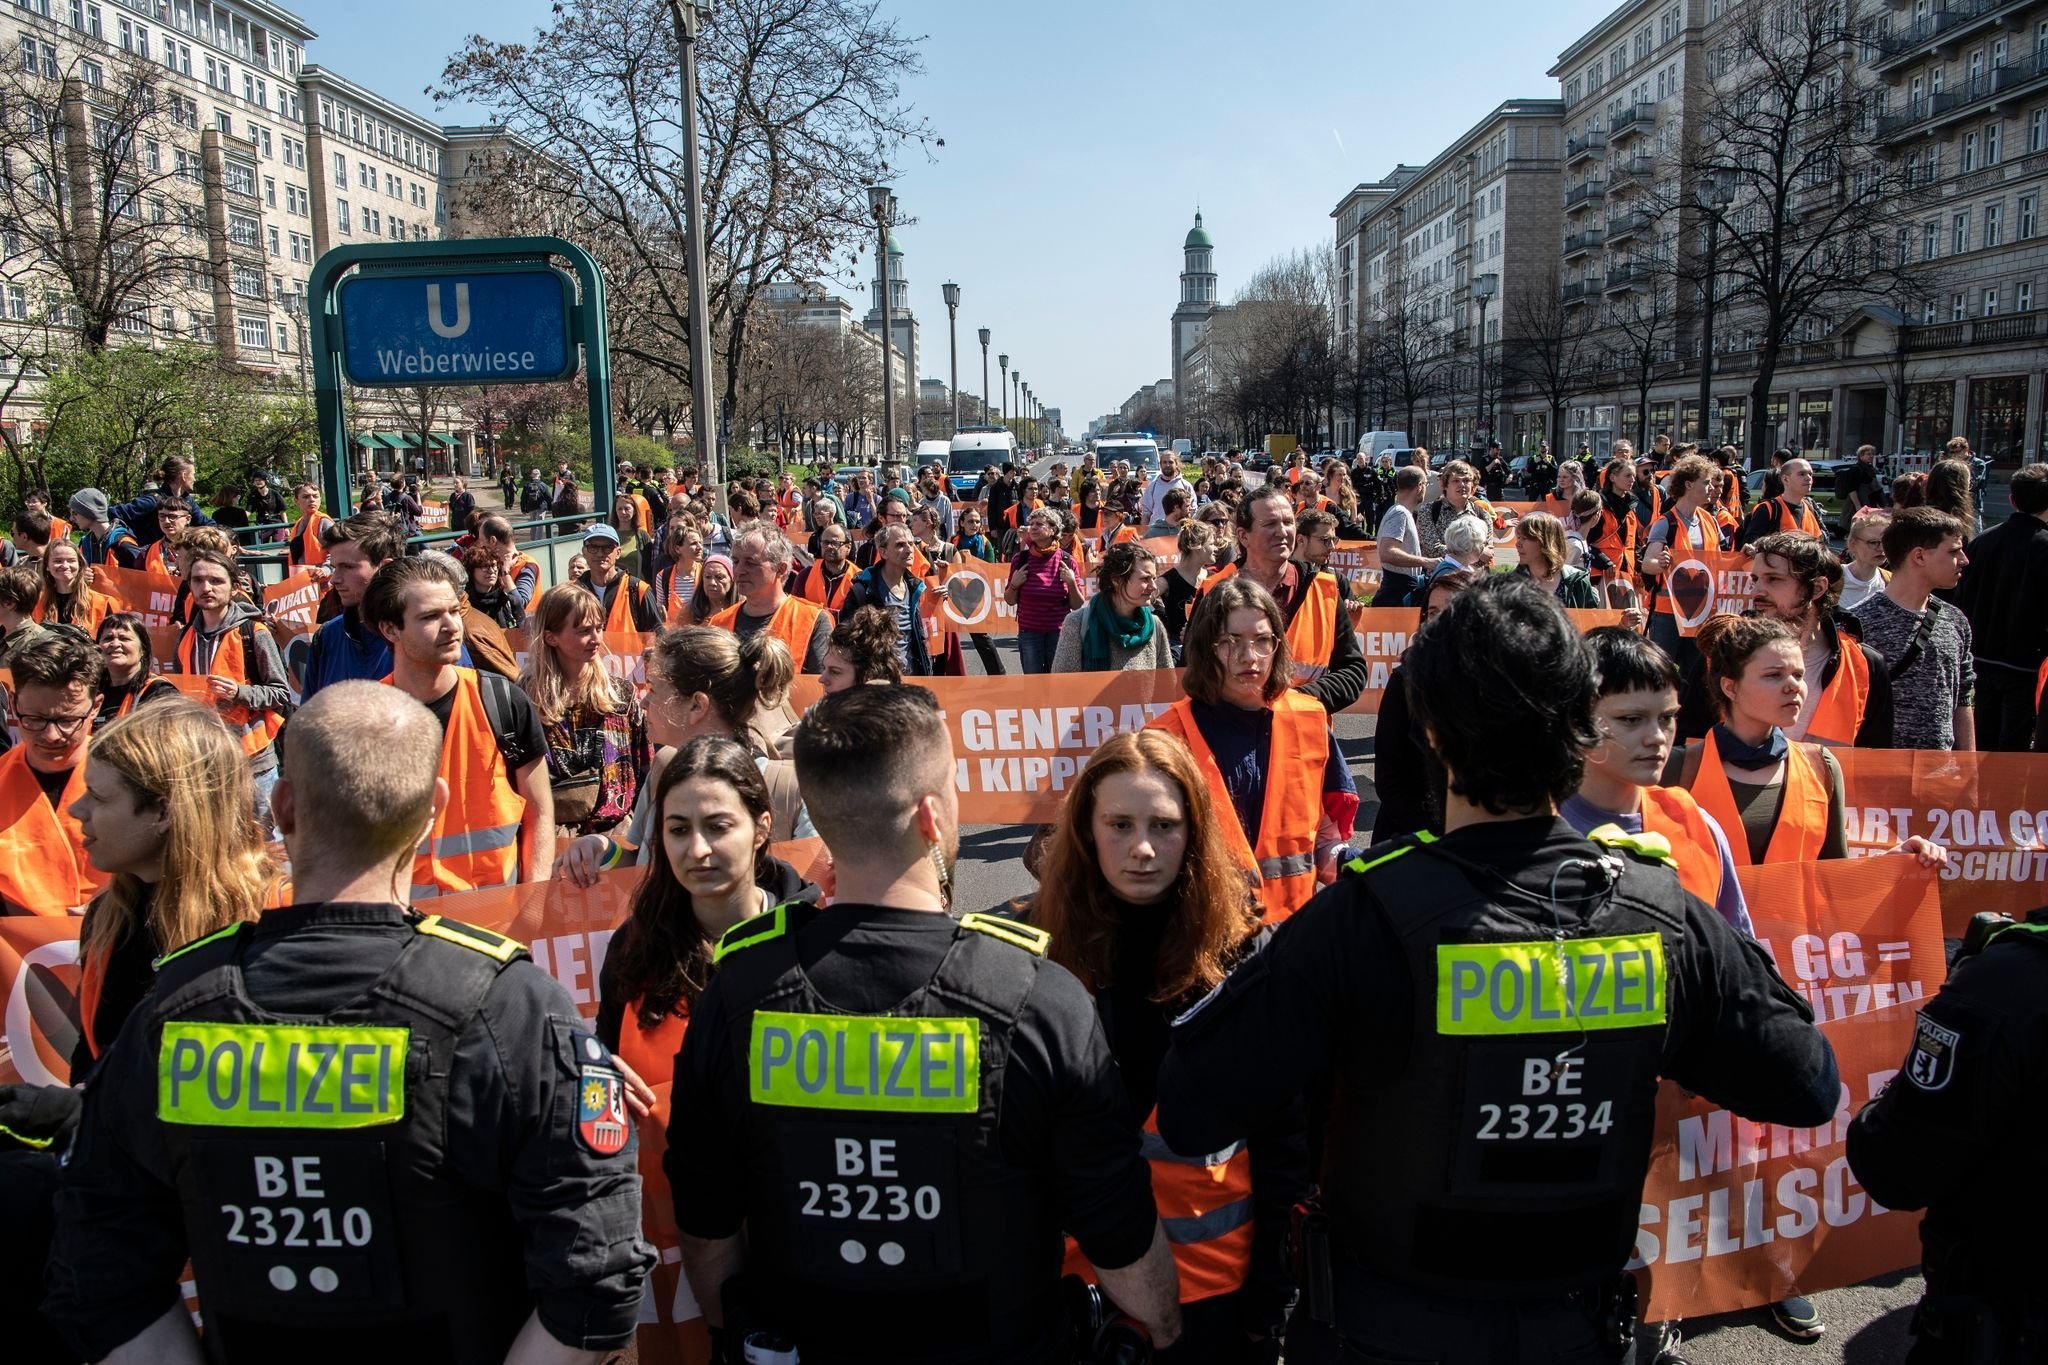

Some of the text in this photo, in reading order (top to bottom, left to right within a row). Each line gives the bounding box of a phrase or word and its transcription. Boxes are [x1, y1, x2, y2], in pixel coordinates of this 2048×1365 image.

[426, 282, 471, 338] U
[377, 346, 535, 375] Weberwiese
[1927, 808, 2005, 847] 20A
[1791, 931, 1866, 981] GG
[1450, 949, 1655, 1022] POLIZEI
[1918, 1018, 1954, 1048] POLIZEI
[170, 1037, 391, 1114] POLIZEI
[761, 1027, 965, 1098] POLIZEI
[1521, 1057, 1585, 1097] BE
[1475, 1102, 1613, 1140] 23234
[253, 1156, 325, 1199] BE
[834, 1137, 899, 1178] BE
[800, 1181, 941, 1221] 23230
[220, 1204, 373, 1247] 23210
